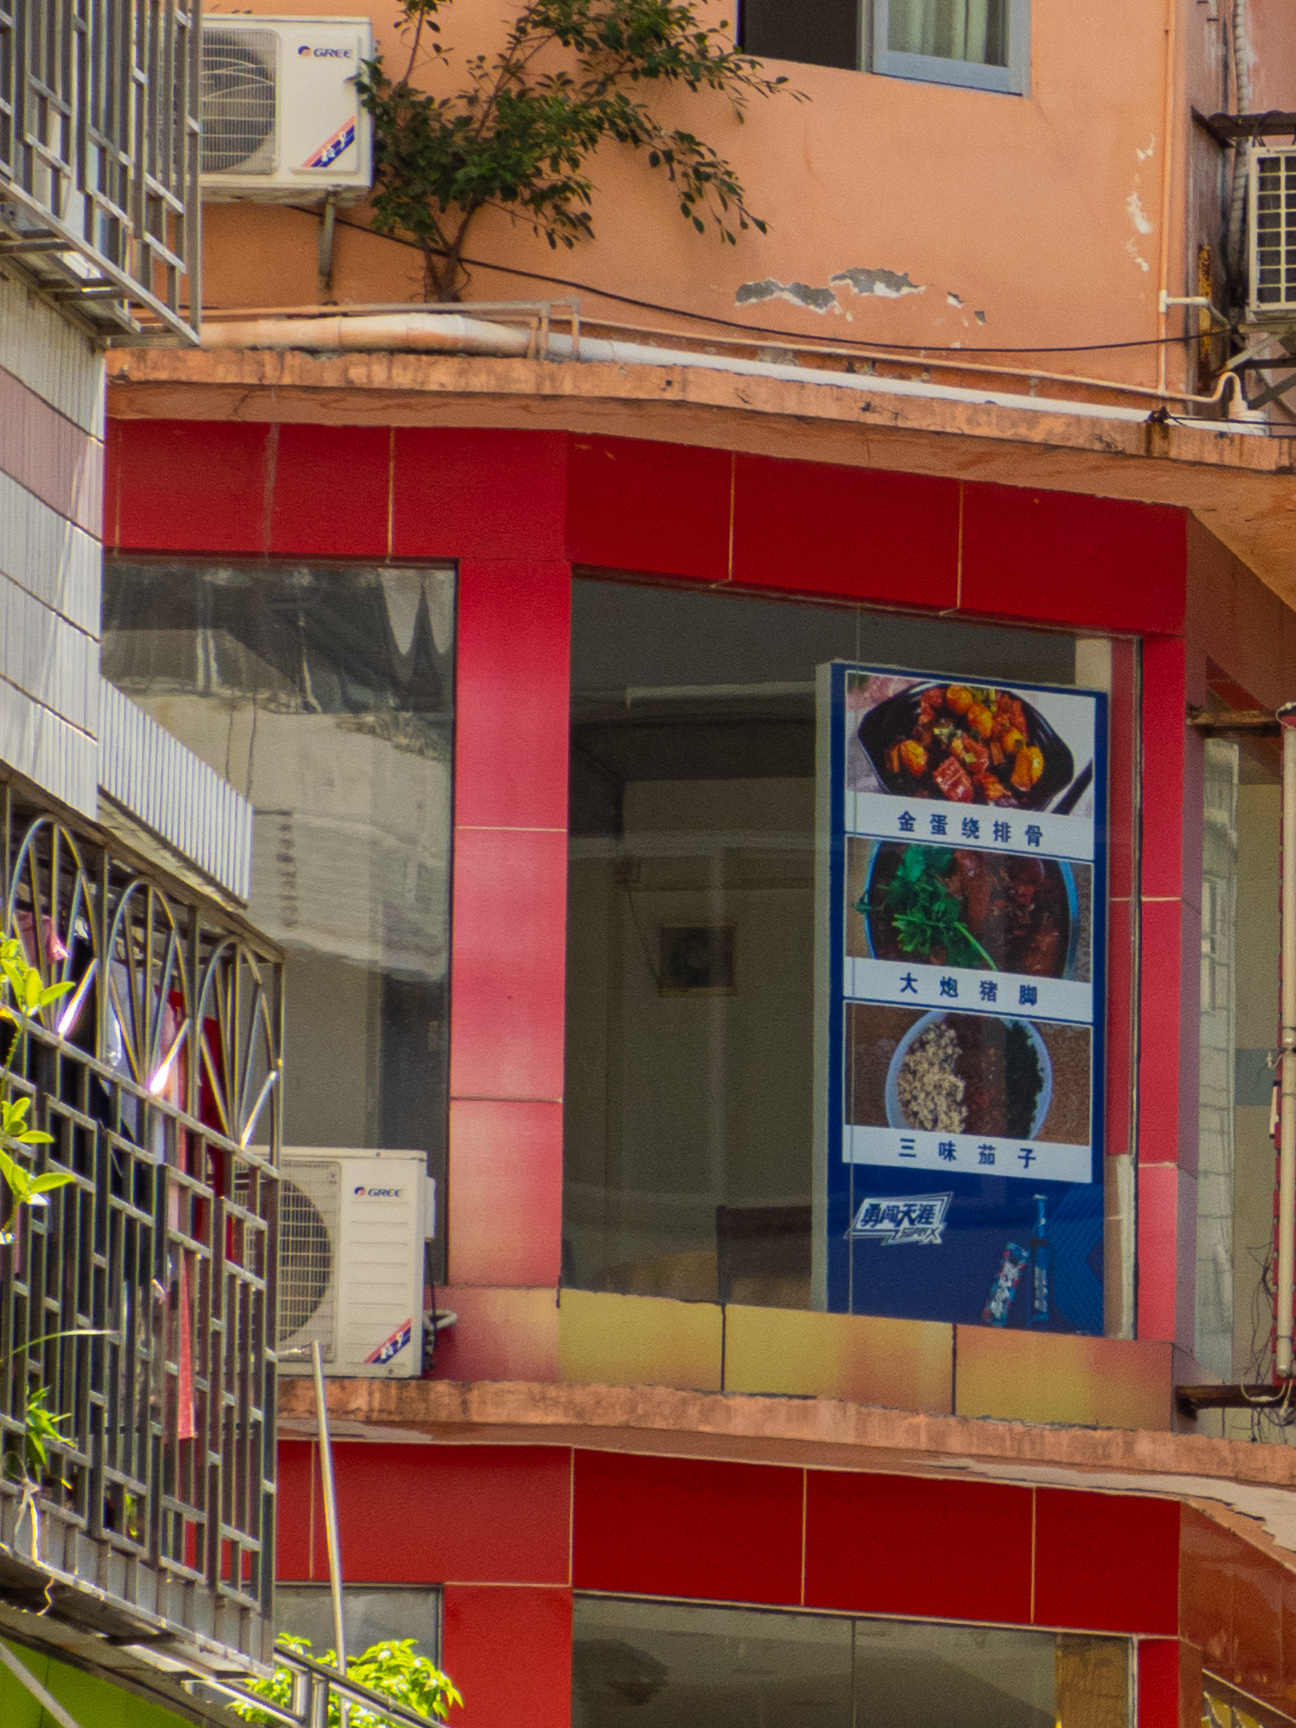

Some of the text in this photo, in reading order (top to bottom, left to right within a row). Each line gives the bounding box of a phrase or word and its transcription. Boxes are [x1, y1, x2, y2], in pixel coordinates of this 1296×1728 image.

[313, 47, 353, 59] GREE
[898, 972, 1039, 1008] 大炮猪脚
[897, 1137, 1037, 1170] 三味茄子
[367, 1187, 402, 1198] GREE
[860, 1202, 938, 1229] 勇闯天涯
